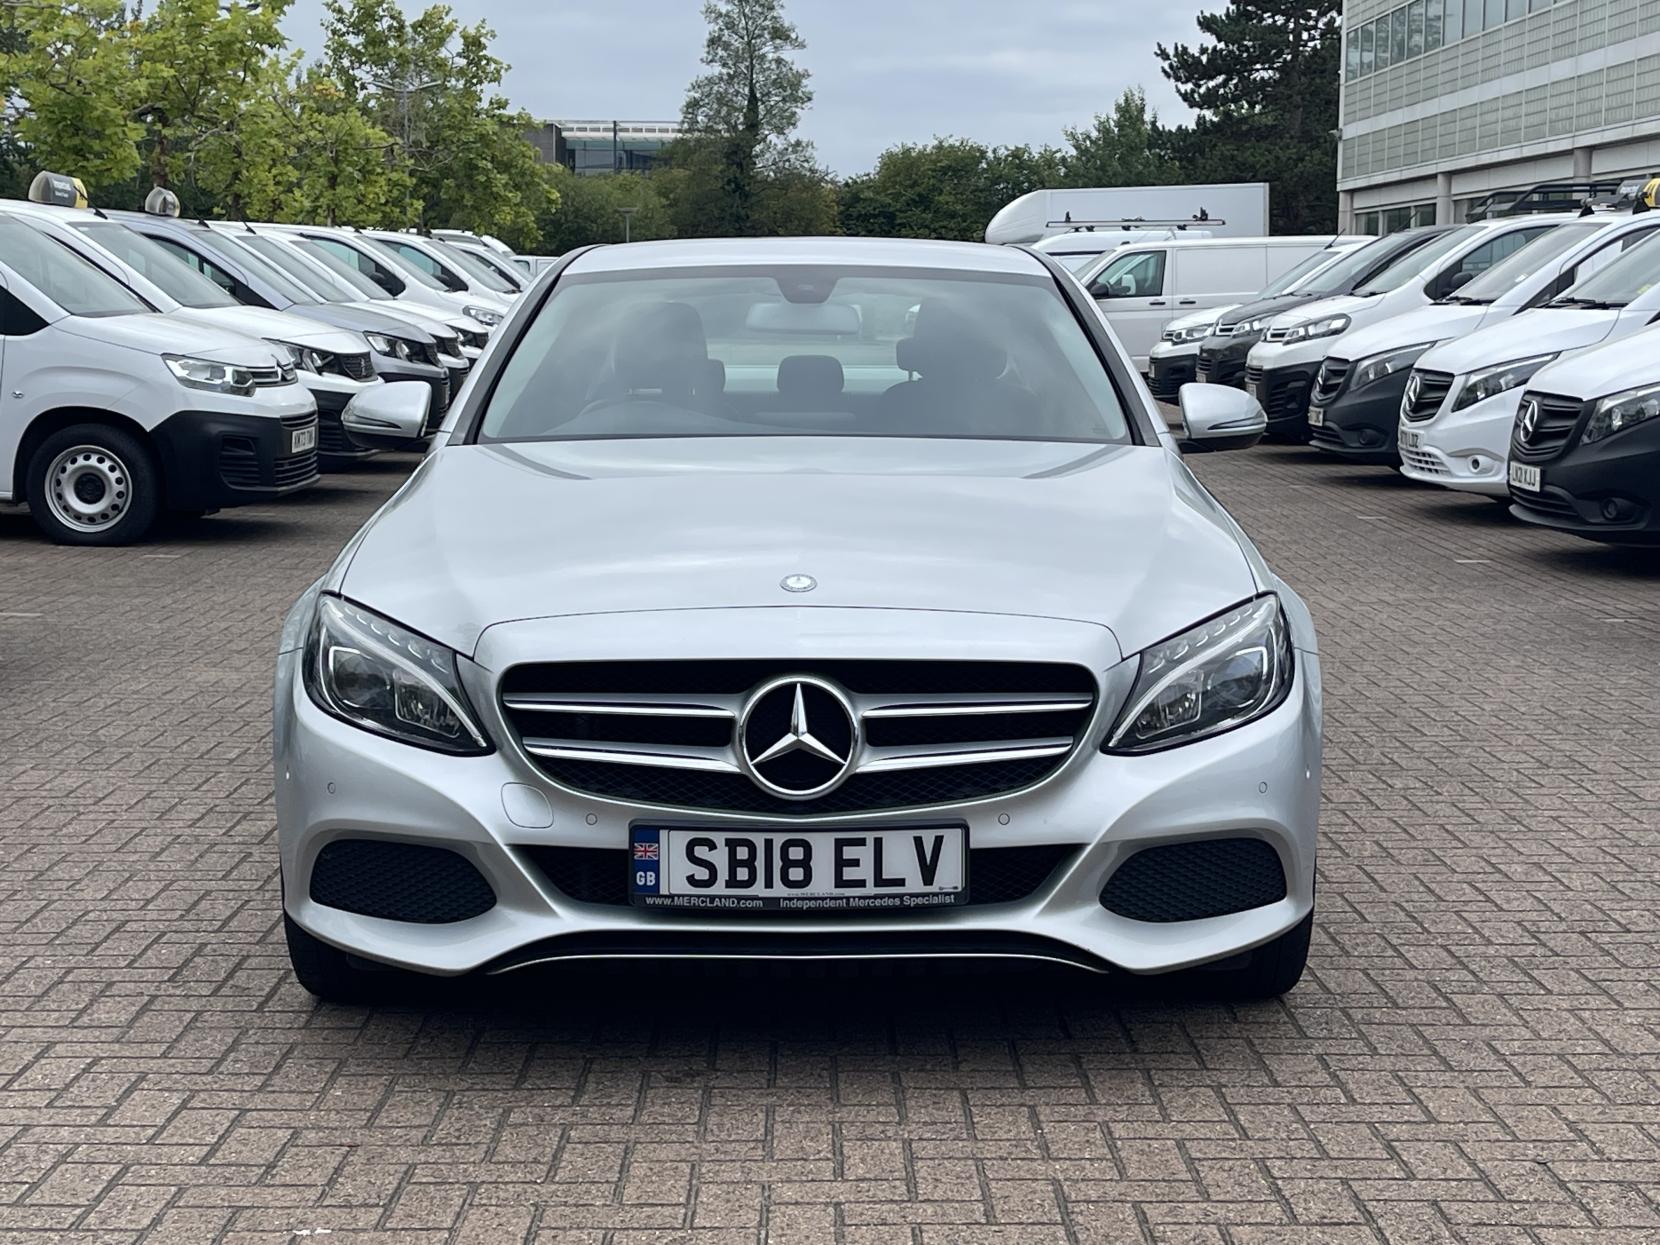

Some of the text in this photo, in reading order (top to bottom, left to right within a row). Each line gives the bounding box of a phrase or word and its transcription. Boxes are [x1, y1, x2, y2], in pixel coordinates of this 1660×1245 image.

[685, 834, 945, 889] SB18 ELV
[636, 871, 656, 886] GB
[645, 896, 764, 908] www.MERCLAND.com
[779, 894, 956, 909] Independent Mercedes Specialist
